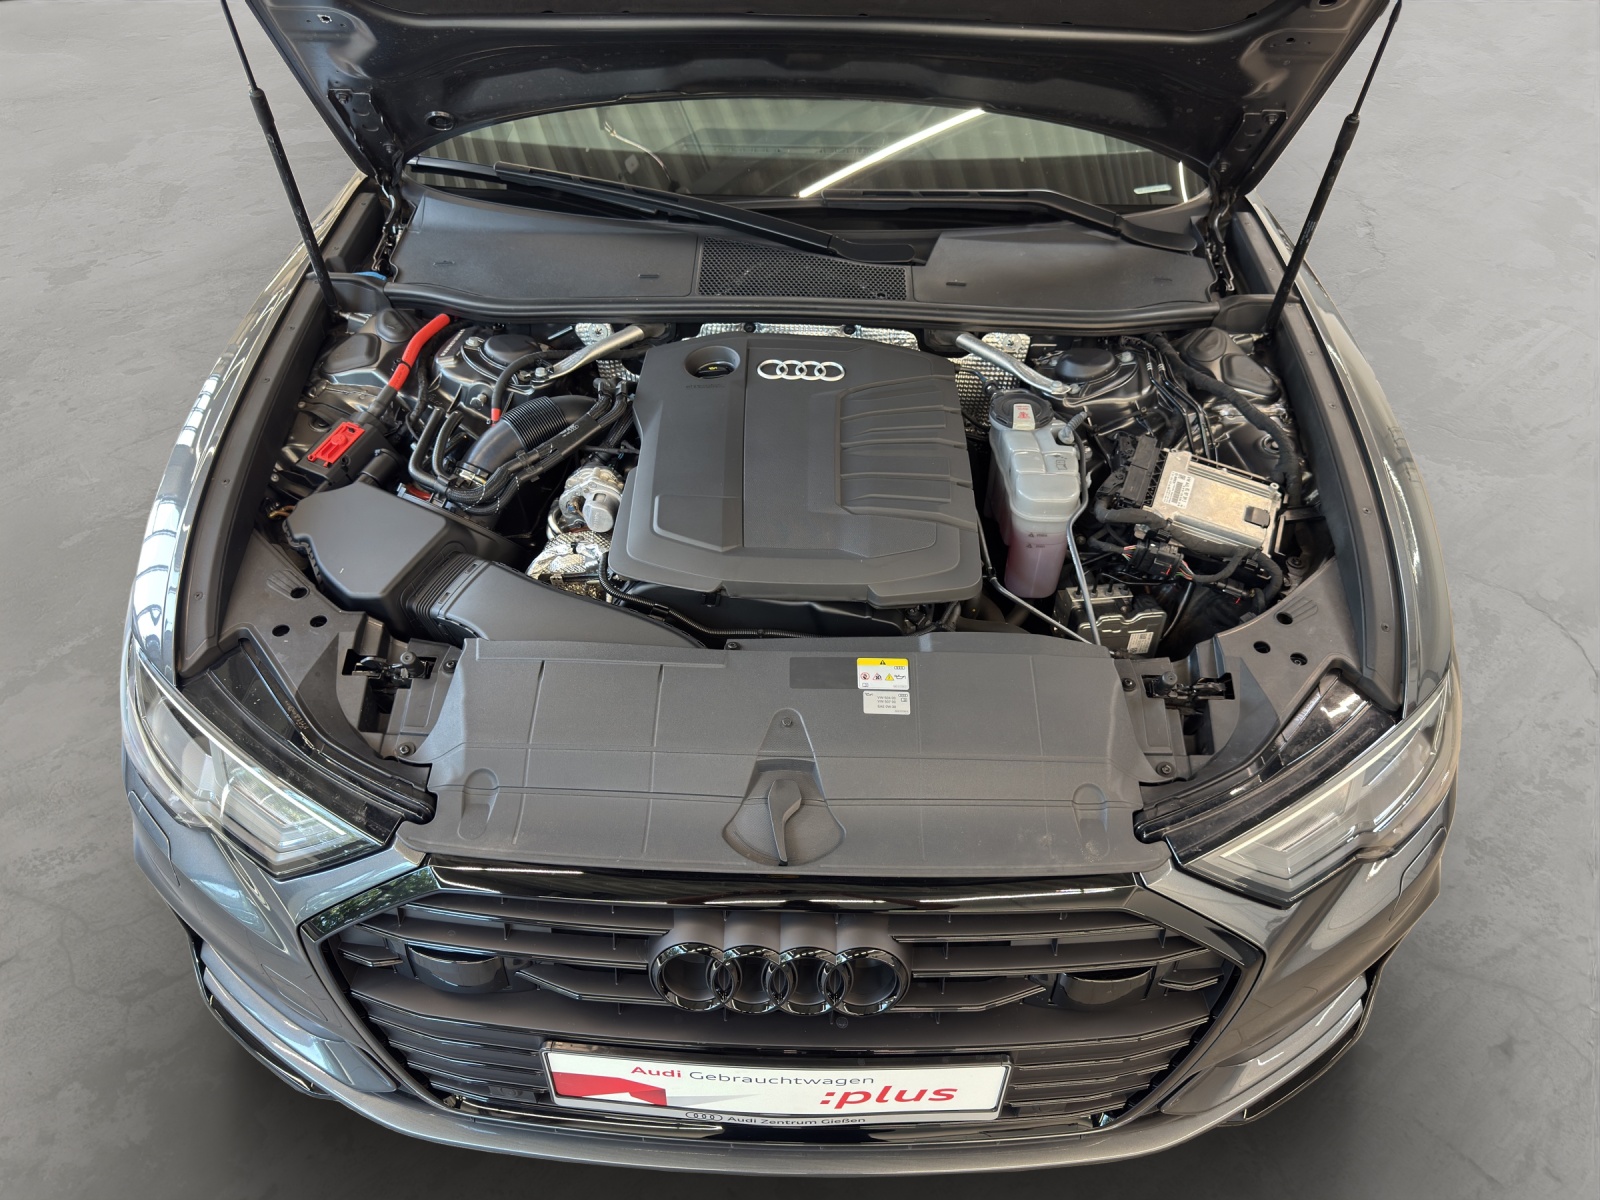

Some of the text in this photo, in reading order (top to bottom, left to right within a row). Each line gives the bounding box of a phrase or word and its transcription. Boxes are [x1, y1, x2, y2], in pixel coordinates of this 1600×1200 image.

[631, 1066, 875, 1087] Audi Gebrauchtwagen
[727, 1115, 866, 1126] Audi Zentrum Gießen
